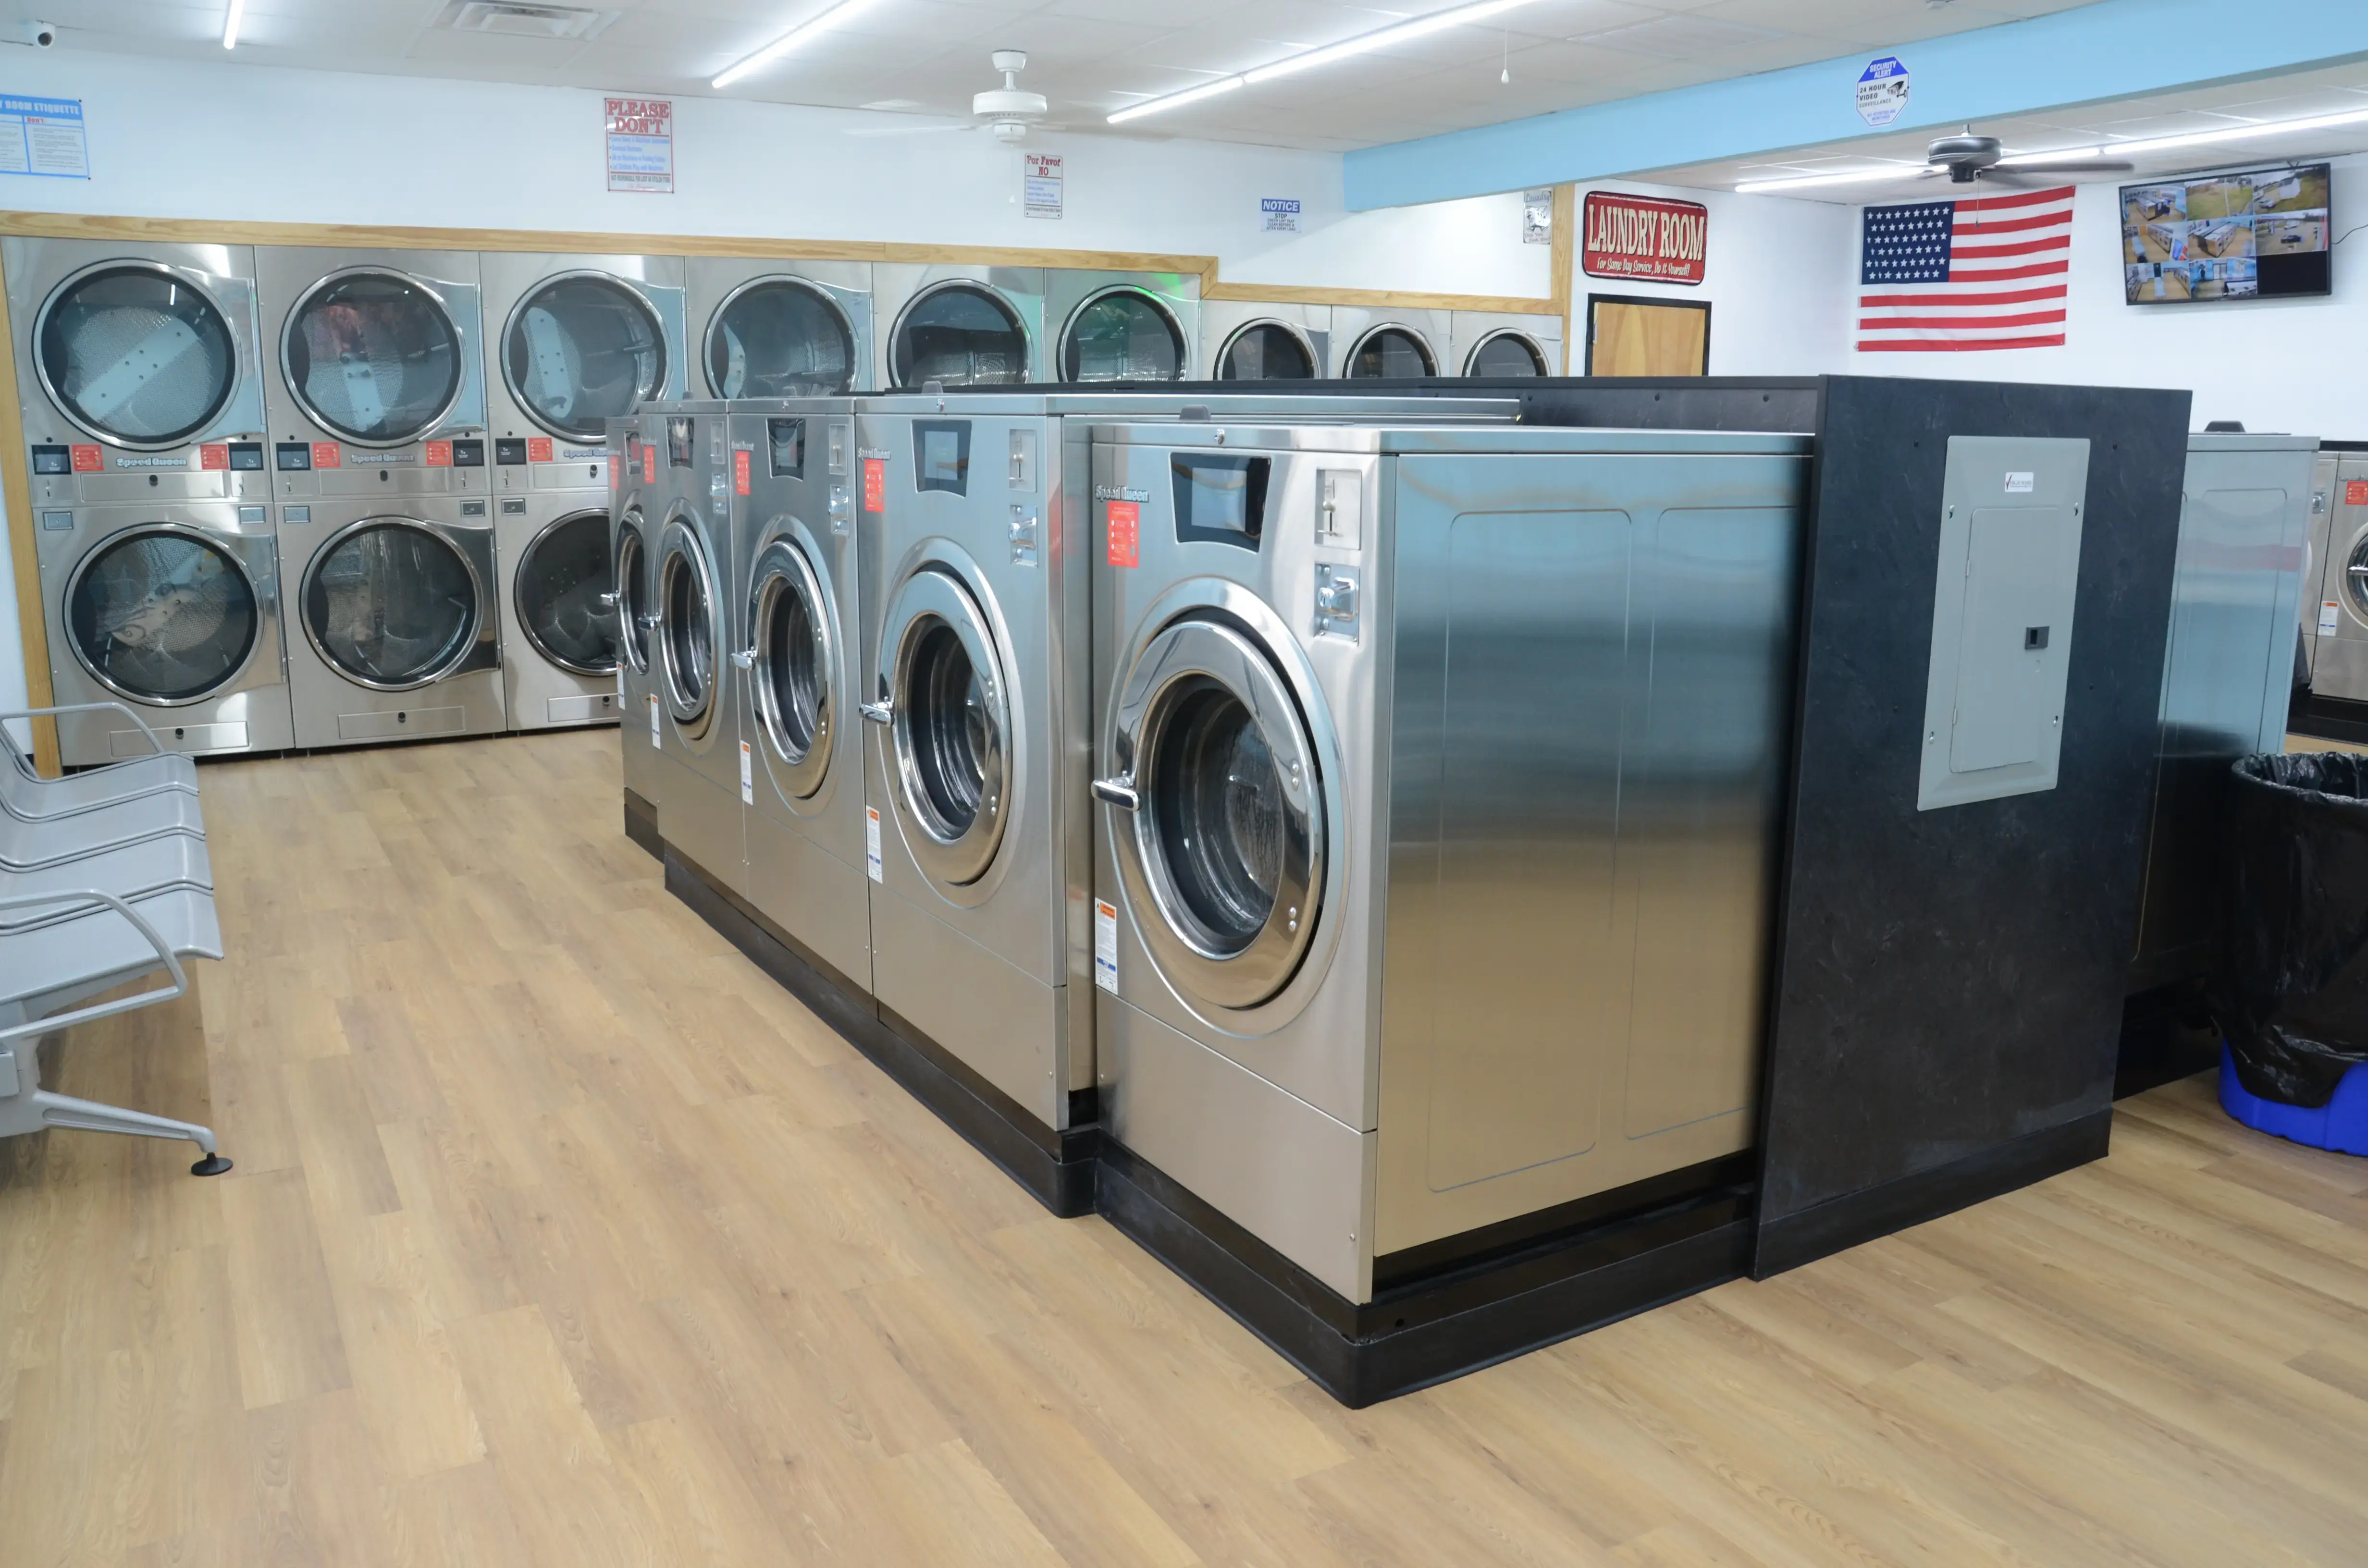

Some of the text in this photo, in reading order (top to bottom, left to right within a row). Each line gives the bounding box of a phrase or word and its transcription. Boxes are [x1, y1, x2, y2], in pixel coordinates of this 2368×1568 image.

[1869, 60, 1897, 73] SECURITY
[1874, 69, 1892, 79] ALERT
[1860, 93, 1878, 101] VIDEO
[33, 102, 80, 115] ETIQUETTE
[1859, 98, 1891, 108] SURVEILLANCE
[607, 101, 669, 118] PLEASE
[614, 117, 664, 134] DON'T
[1027, 155, 1039, 165] Por
[1038, 166, 1049, 176] NO
[1525, 192, 1550, 203] Laundry
[1263, 200, 1299, 211] NOTICE
[1588, 204, 1704, 261] LAUNDRY ROOM
[1597, 257, 1606, 270] For
[1607, 257, 1622, 270] Same
[1623, 257, 1632, 275] Day
[1633, 260, 1653, 275] Service,
[1654, 261, 1661, 273] Do
[1662, 263, 1667, 275] It
[351, 454, 382, 464] Speed
[564, 449, 593, 459] Speed
[116, 457, 187, 468] Speed Queen
[1095, 484, 1149, 503] Speed Queen
